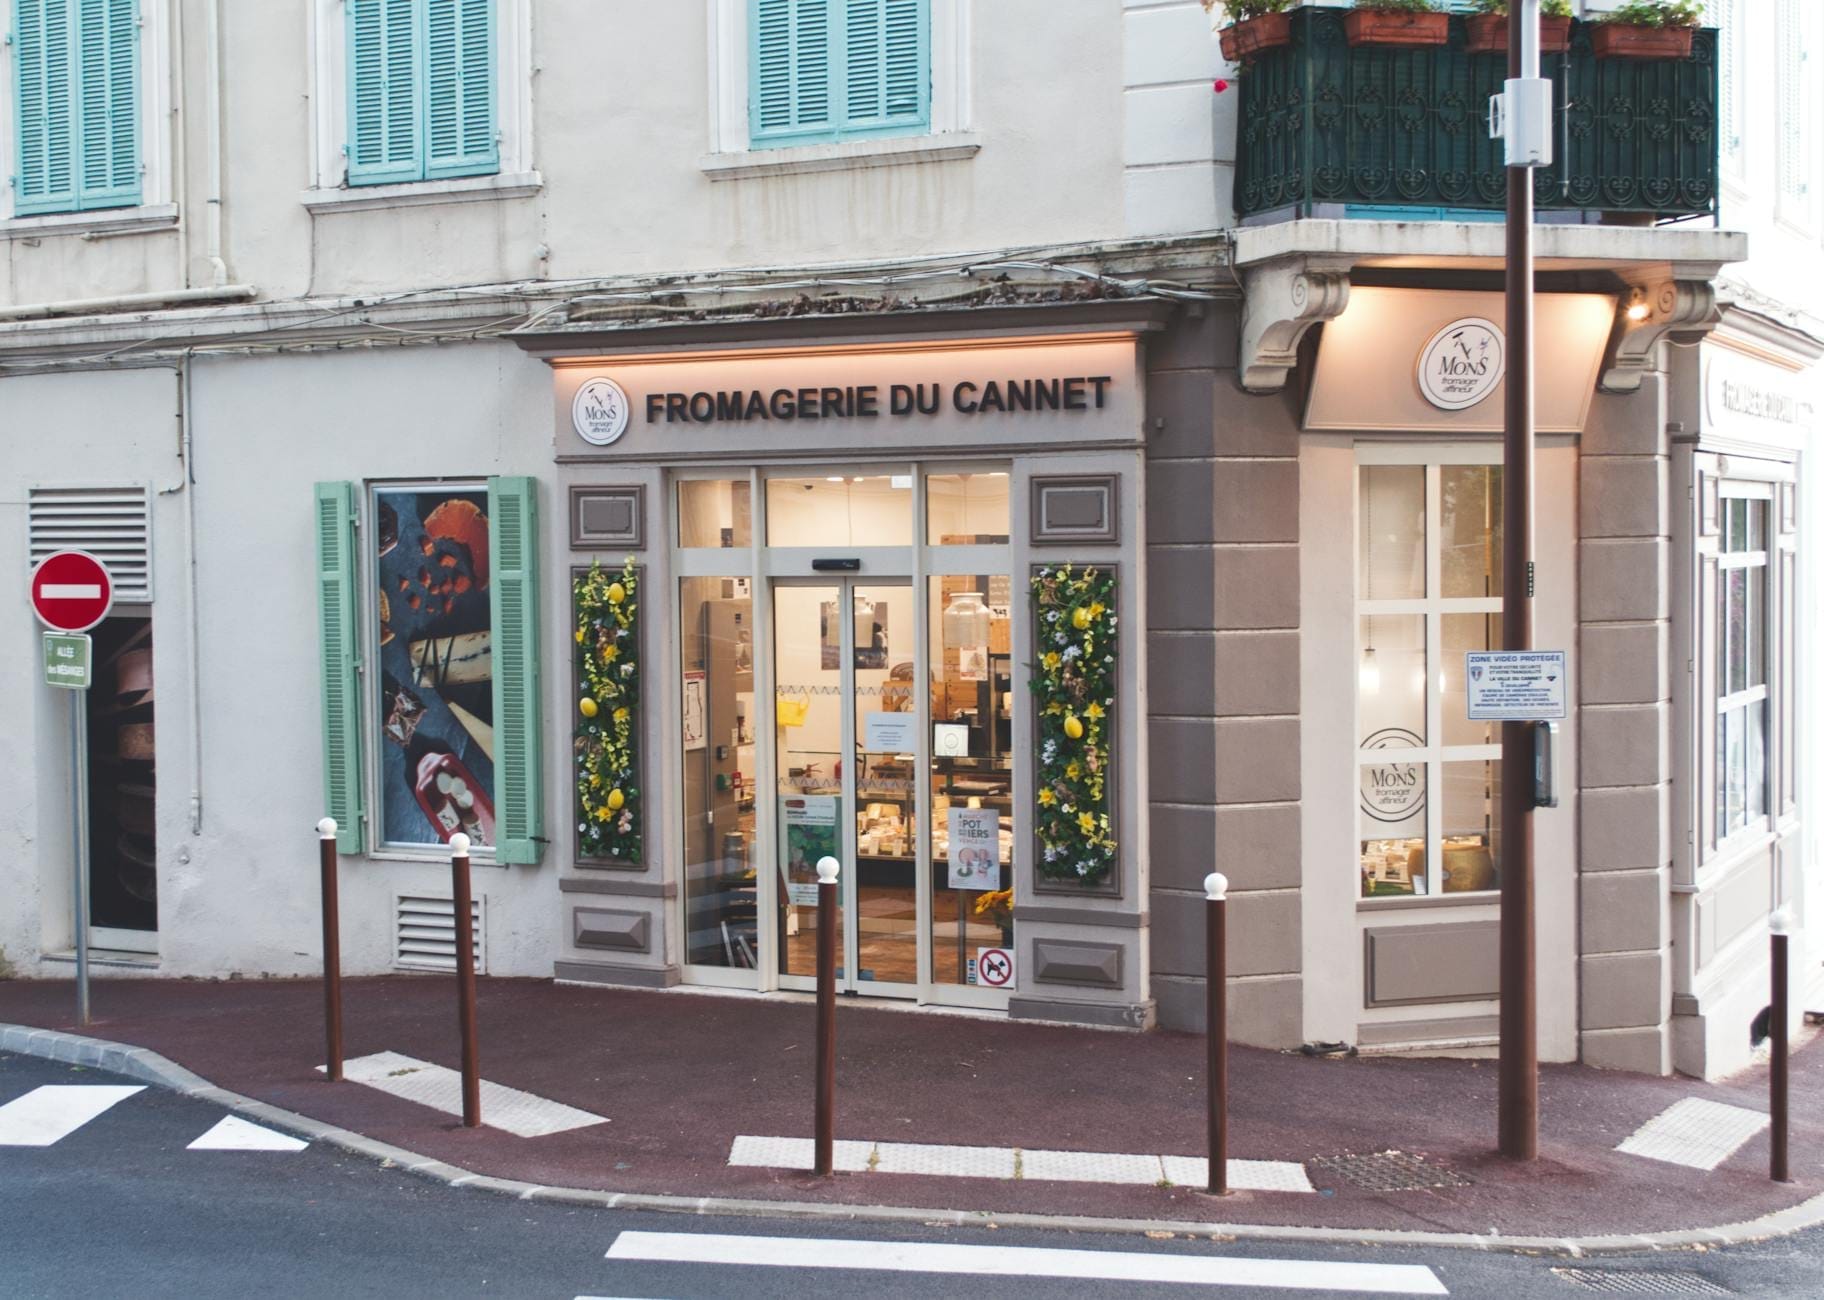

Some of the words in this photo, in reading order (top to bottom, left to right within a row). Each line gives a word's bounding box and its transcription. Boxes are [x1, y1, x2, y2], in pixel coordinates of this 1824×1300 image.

[1438, 356, 1489, 376] MONS
[646, 386, 879, 424] FROMAGERIE
[890, 383, 940, 416] DU
[953, 376, 1112, 414] CANNET
[585, 405, 617, 420] MONS
[1371, 767, 1416, 787] MONS
[962, 819, 982, 829] POT
[967, 829, 989, 838] IERS
